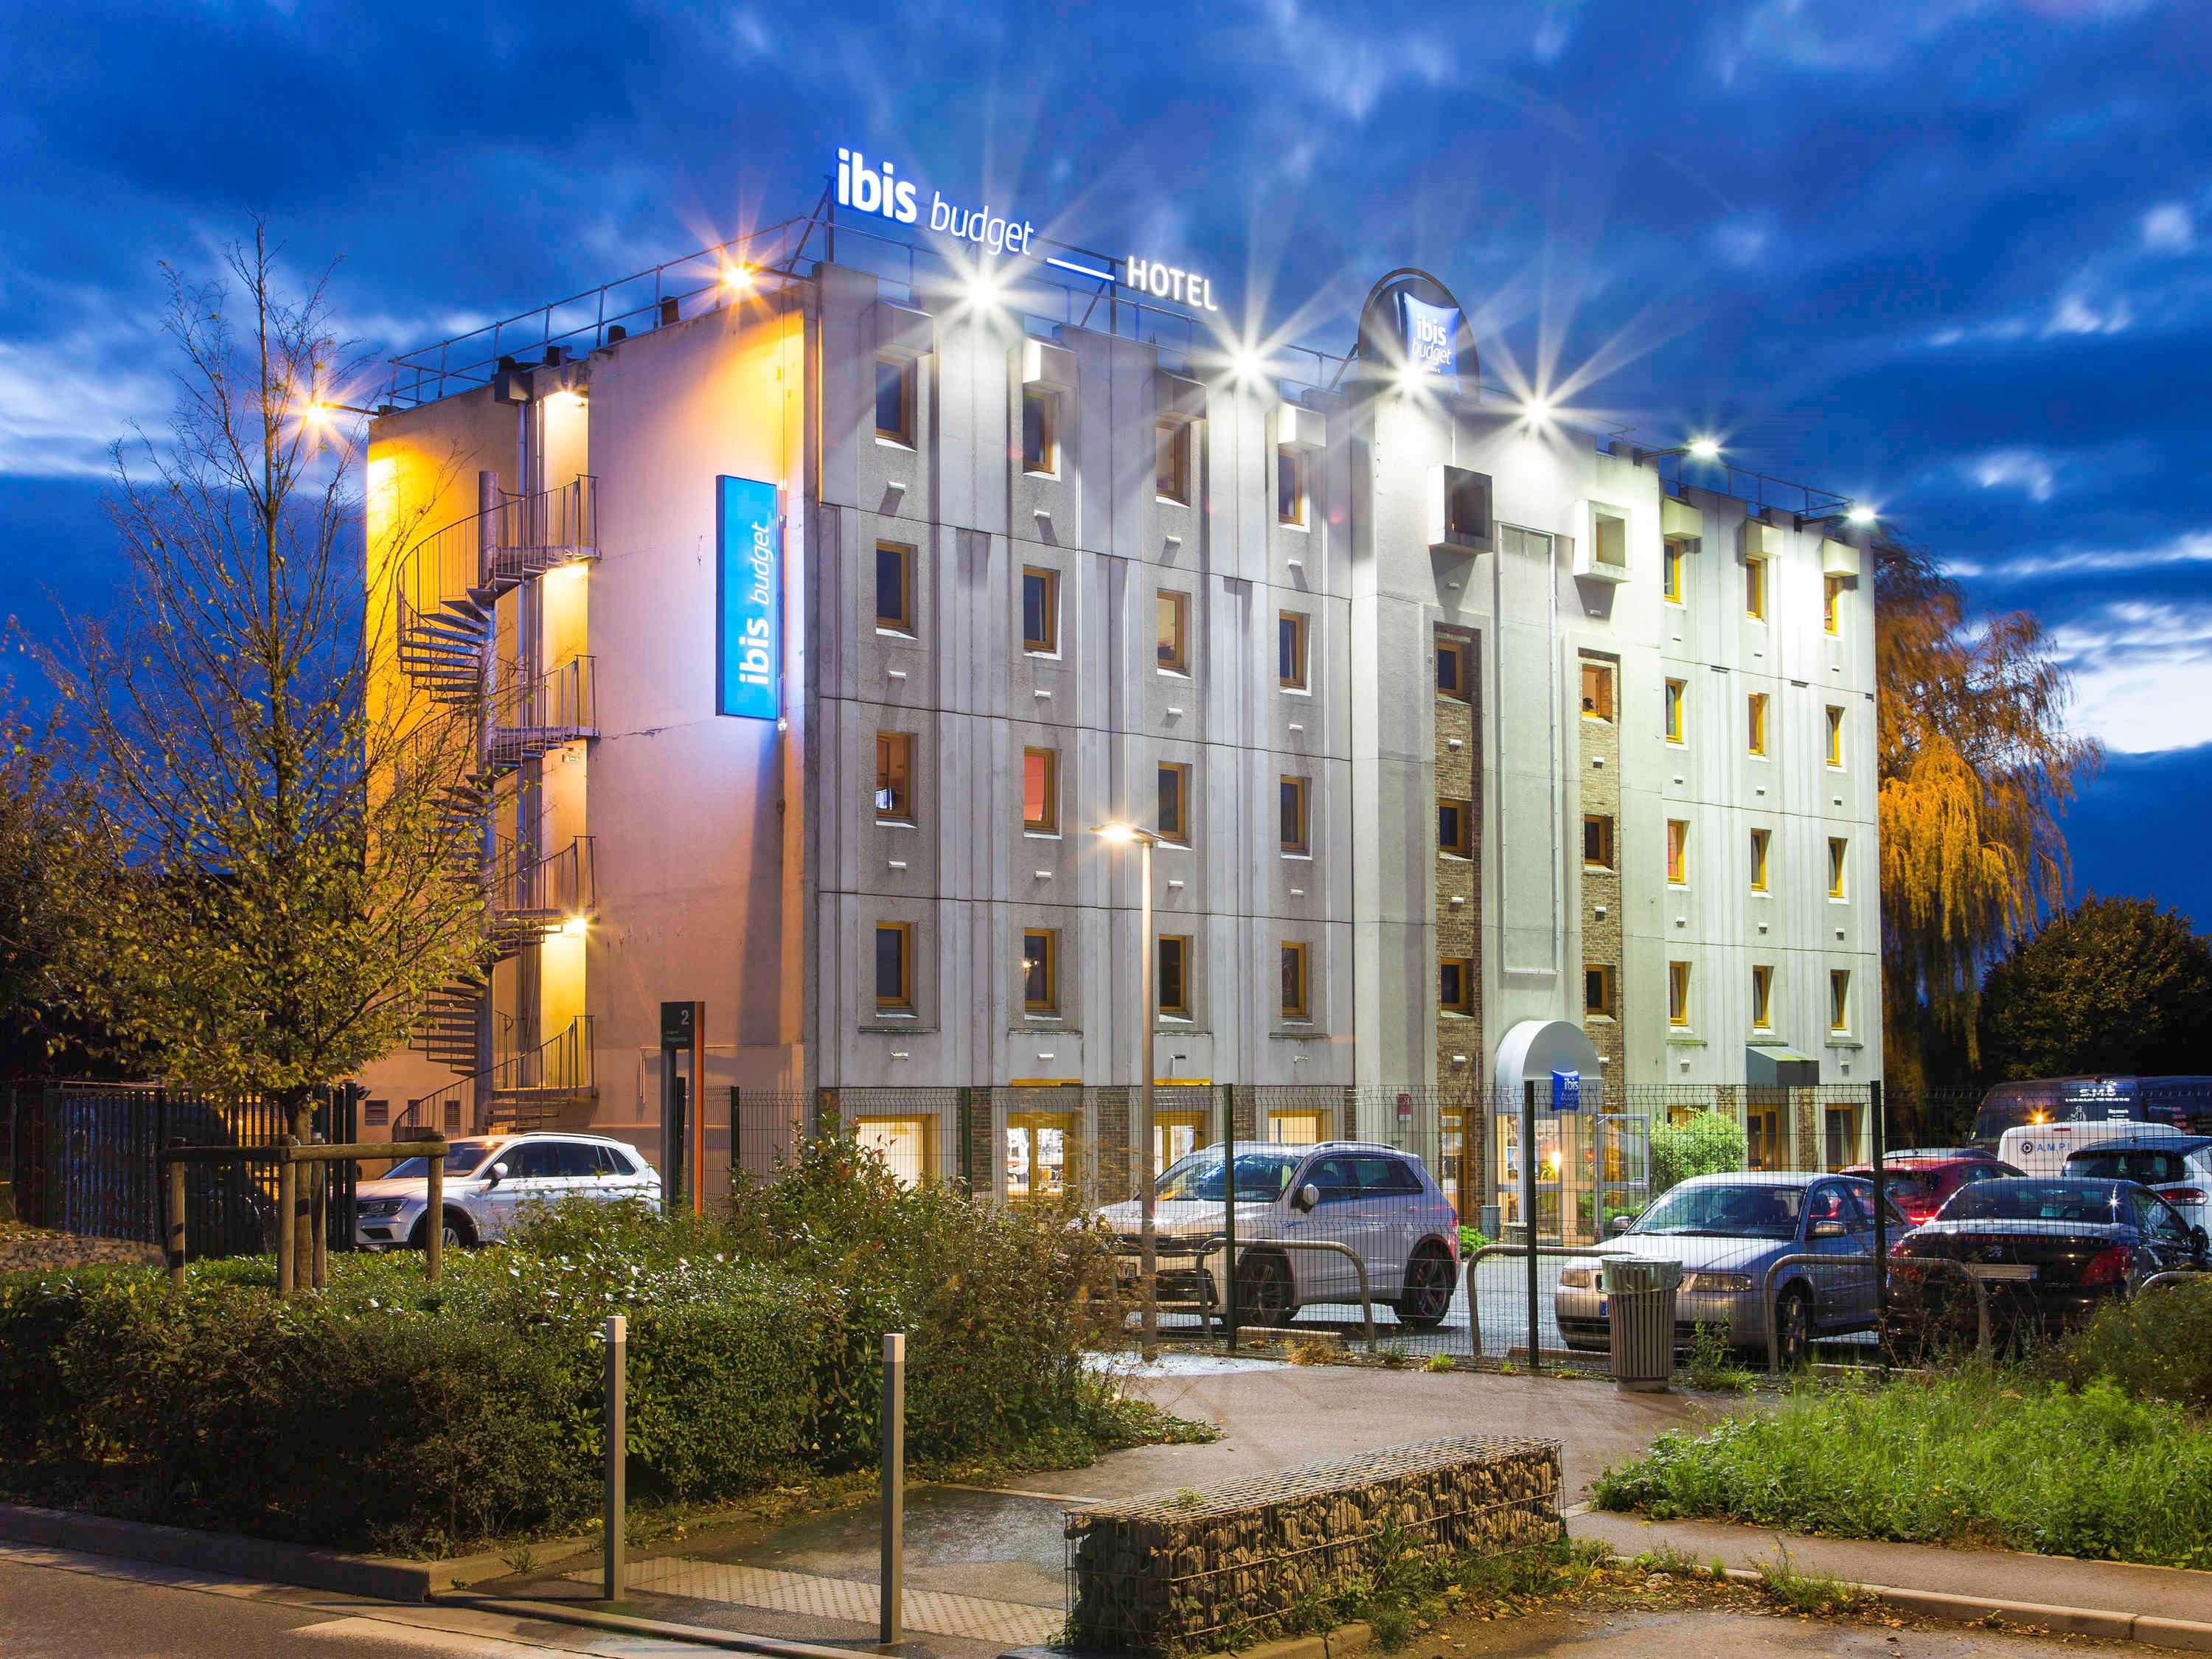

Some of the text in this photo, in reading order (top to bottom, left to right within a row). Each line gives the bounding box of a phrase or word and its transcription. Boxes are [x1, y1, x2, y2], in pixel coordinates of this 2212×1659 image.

[838, 147, 1034, 256] ibis budget
[1127, 256, 1217, 311] HOTEL
[1416, 313, 1447, 347] ibis
[1412, 337, 1452, 365] budget
[739, 521, 773, 685] ibis budget
[681, 1009, 689, 1025] 2
[1564, 1078, 1579, 1091] ibis
